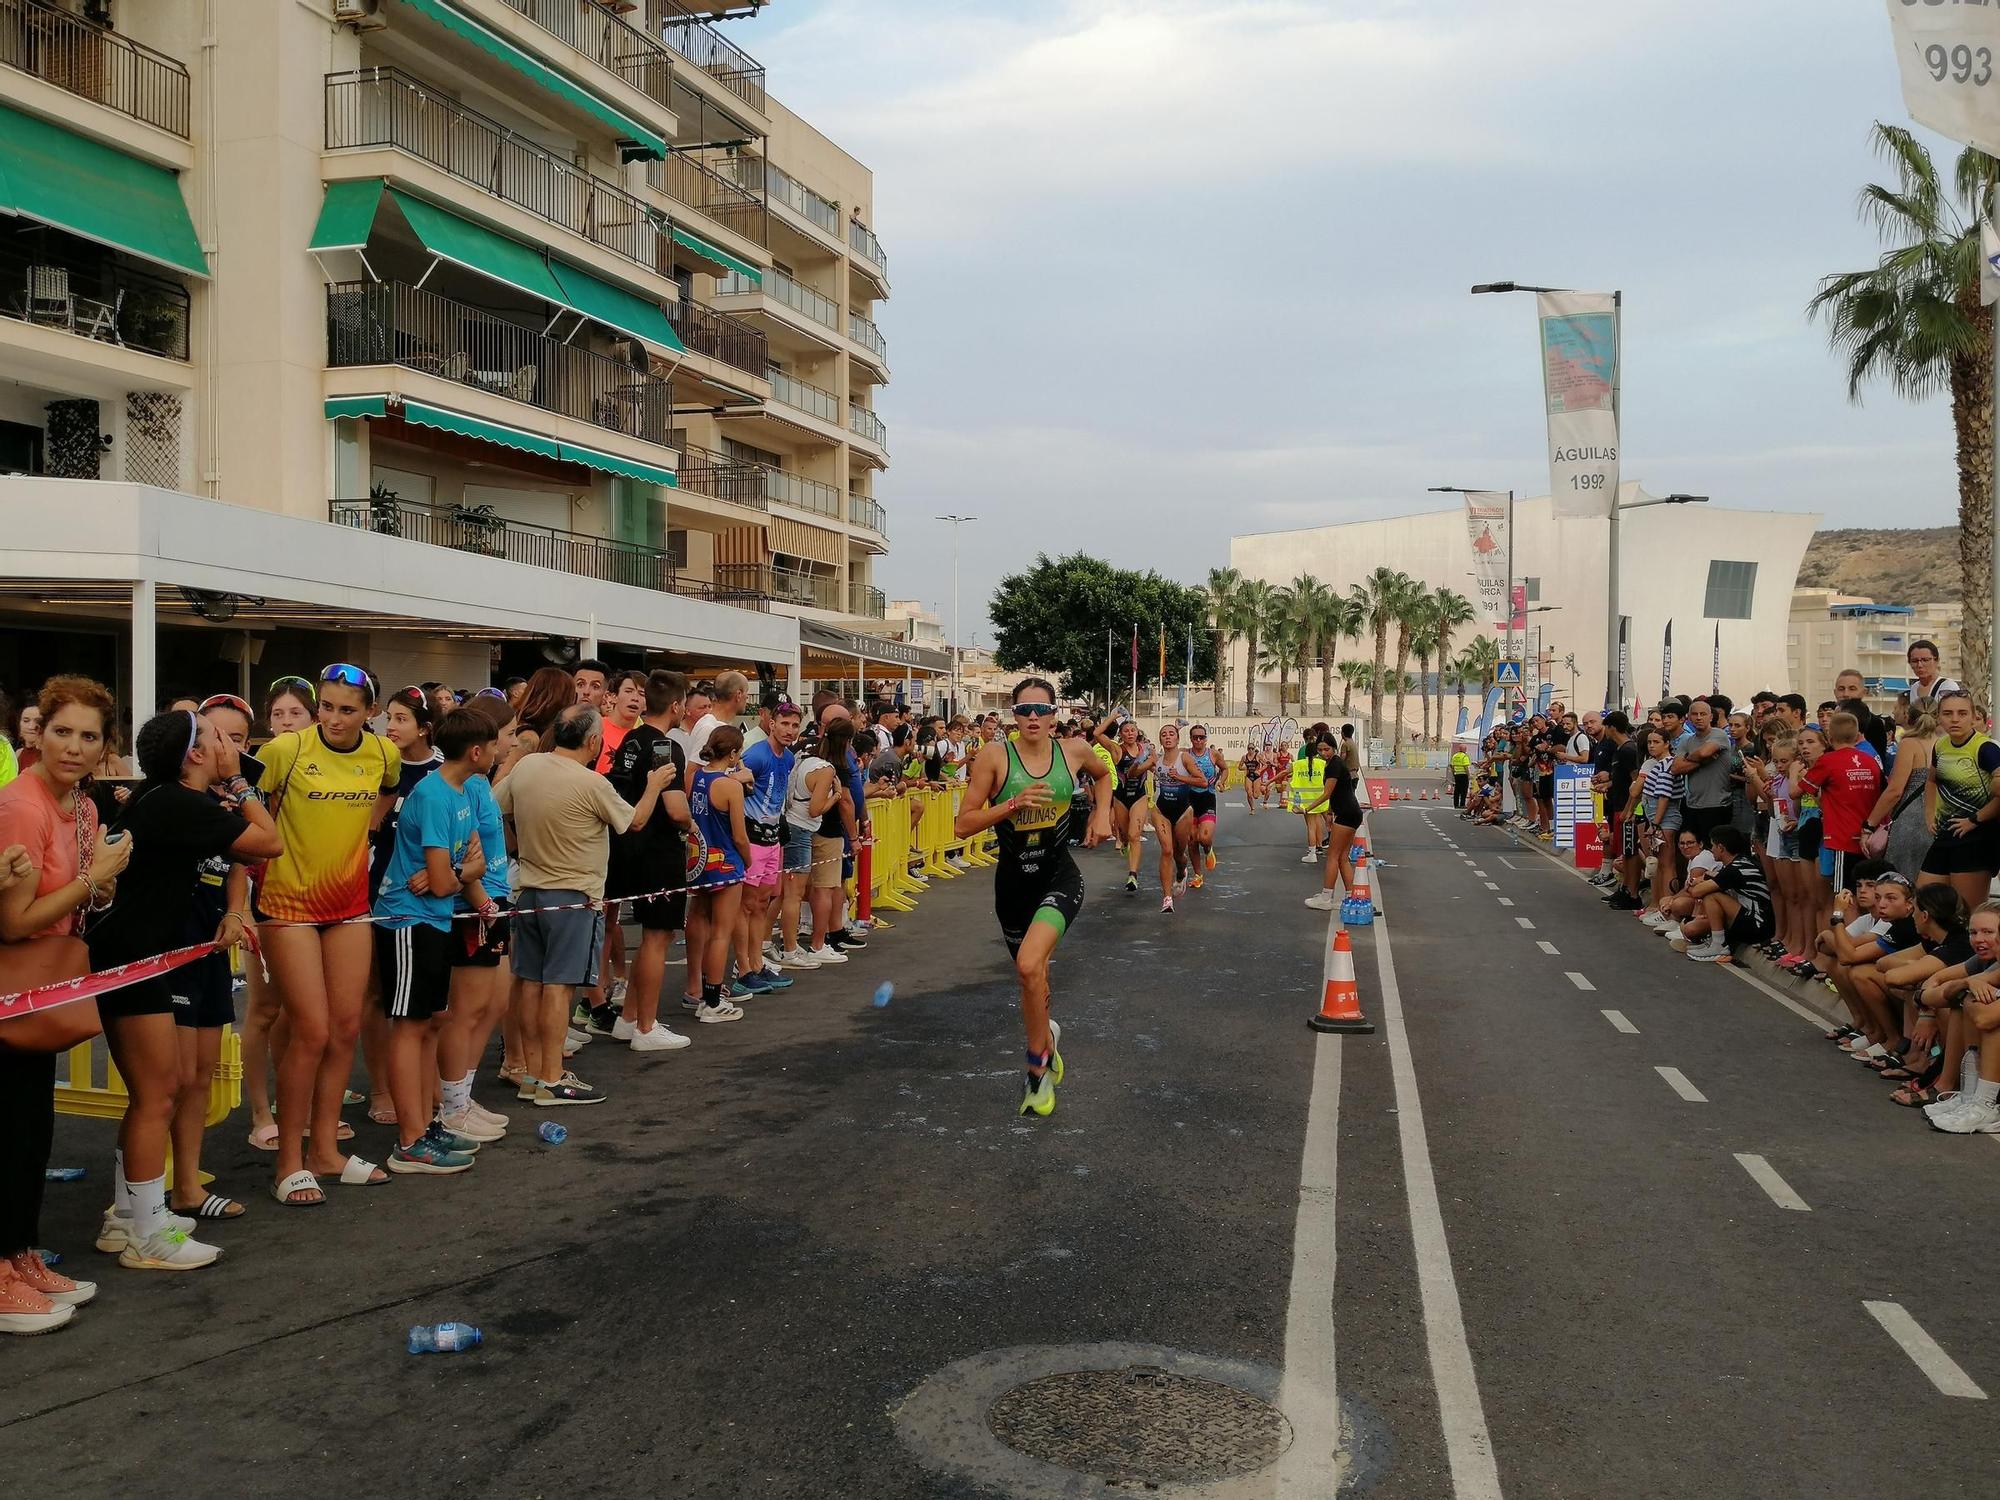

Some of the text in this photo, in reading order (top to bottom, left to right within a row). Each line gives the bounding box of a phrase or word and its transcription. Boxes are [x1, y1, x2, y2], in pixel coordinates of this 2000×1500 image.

[1914, 43, 1992, 87] 993
[1554, 446, 1617, 463] ÁGUILAS
[852, 636, 920, 662] BAR CAFETERIA
[1209, 726, 1240, 735] DITORIO
[1241, 726, 1247, 735] Y
[1297, 770, 1322, 778] PRESA
[1561, 781, 1587, 790] 67 E
[308, 789, 378, 801] españa
[1016, 806, 1057, 826] AULINAS
